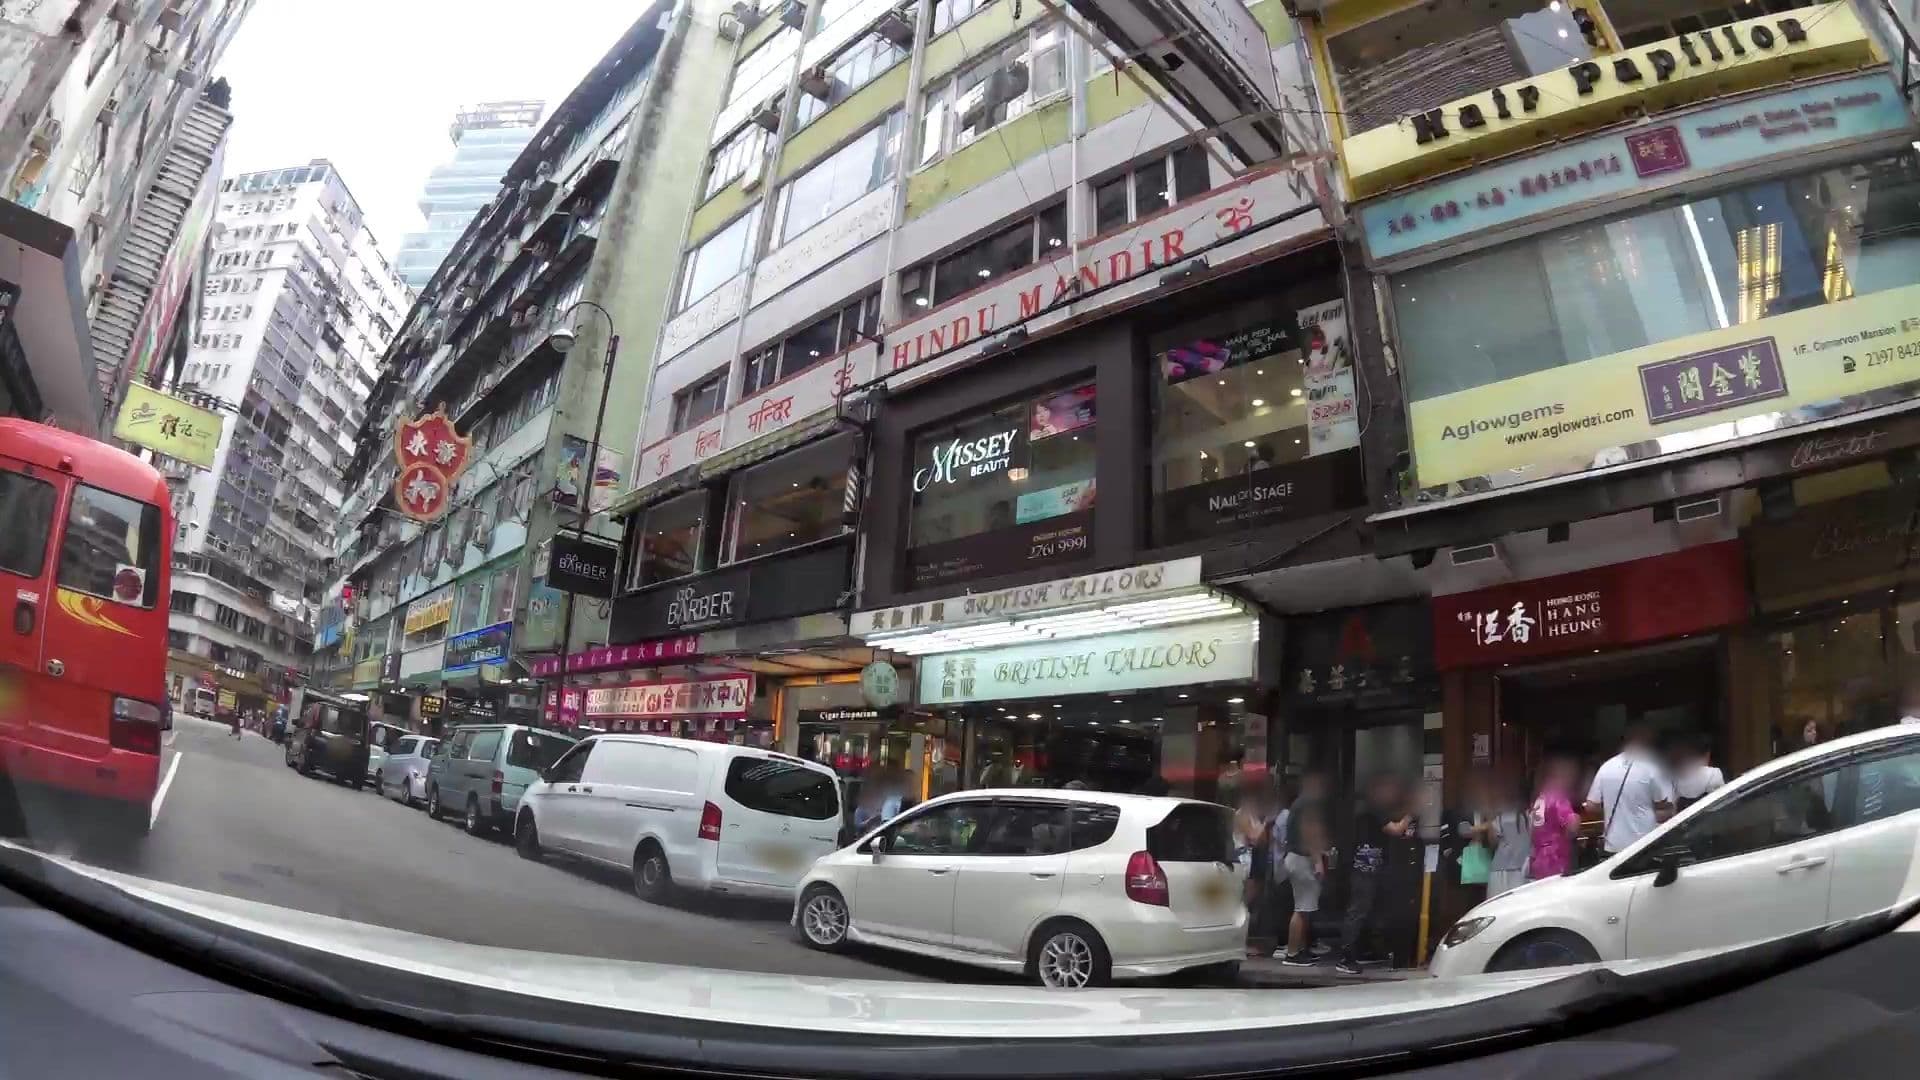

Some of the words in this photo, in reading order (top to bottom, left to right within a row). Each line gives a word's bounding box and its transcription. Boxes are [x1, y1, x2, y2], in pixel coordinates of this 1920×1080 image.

[1411, 85, 1540, 144] Hair
[1568, 18, 1808, 96] Papillon
[892, 303, 998, 370] HINDU
[1018, 227, 1187, 319] MANDIR
[1441, 402, 1566, 441] Aglowgems
[1505, 407, 1635, 445] www.aglowdzi.com
[970, 457, 1011, 477] BEAUTY
[1209, 494, 1239, 512] NAIL
[1253, 482, 1295, 502] STAGE
[1058, 535, 1088, 553] 9991
[559, 556, 608, 580] BARBER
[963, 587, 1050, 616] BRITISH
[1059, 567, 1165, 599] TAILORS
[1546, 595, 1573, 607] HONG
[1574, 590, 1602, 603] KONG
[667, 591, 735, 626] BARBER
[1547, 601, 1602, 621] HANG
[1548, 617, 1603, 637] HEUNG
[993, 651, 1098, 684] BRITISH
[1104, 638, 1224, 672] TAILORS
[820, 711, 839, 721] Cigar
[840, 710, 878, 720] Emporium
